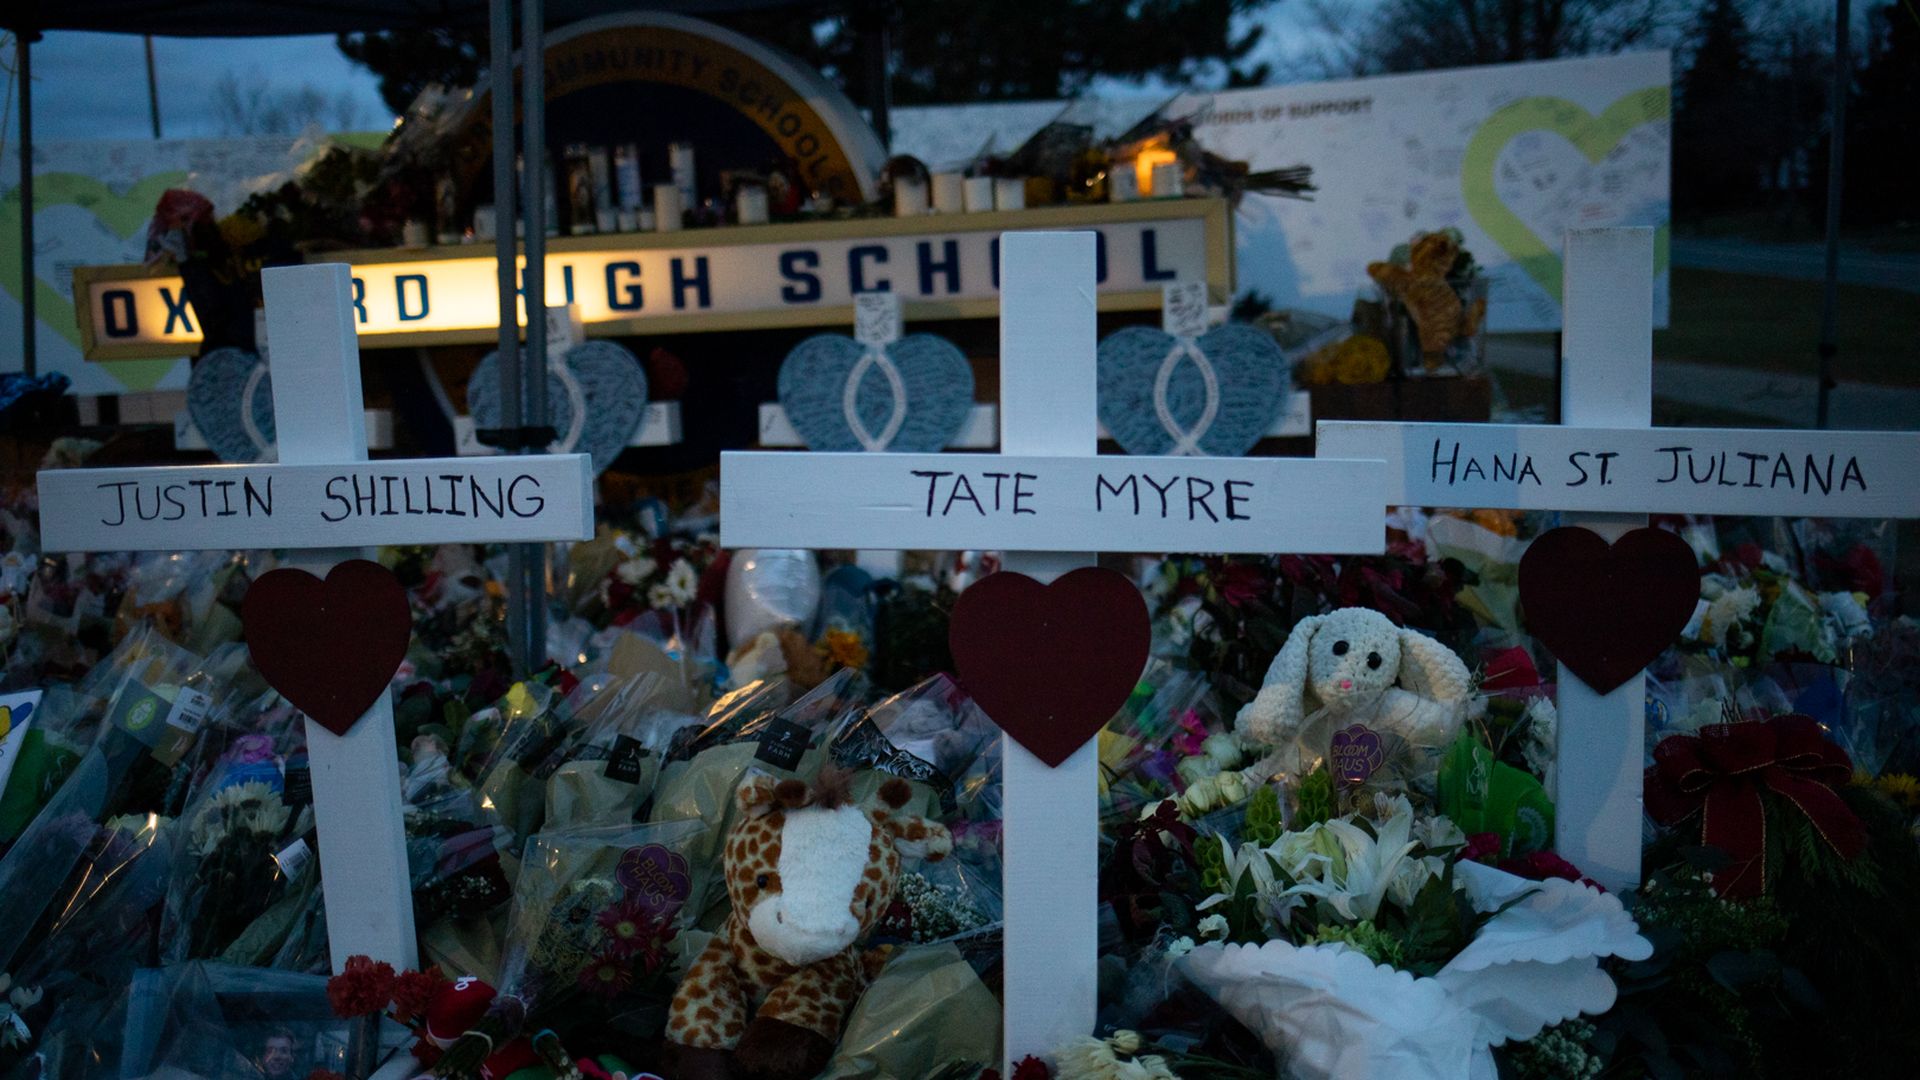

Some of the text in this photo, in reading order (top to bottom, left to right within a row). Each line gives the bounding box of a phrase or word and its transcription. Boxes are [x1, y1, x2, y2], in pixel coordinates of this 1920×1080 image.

[544, 48, 708, 88] MMUNITY
[1287, 96, 1373, 119] SUPPORT
[101, 229, 1178, 339] OXD IGH SCHL
[1431, 438, 1542, 486] HANA
[1656, 446, 1867, 495] JULIANA
[98, 473, 545, 526] JUSTIN SHILLING
[910, 470, 1254, 523] TATE MYRE
[630, 866, 665, 906] HAUS
